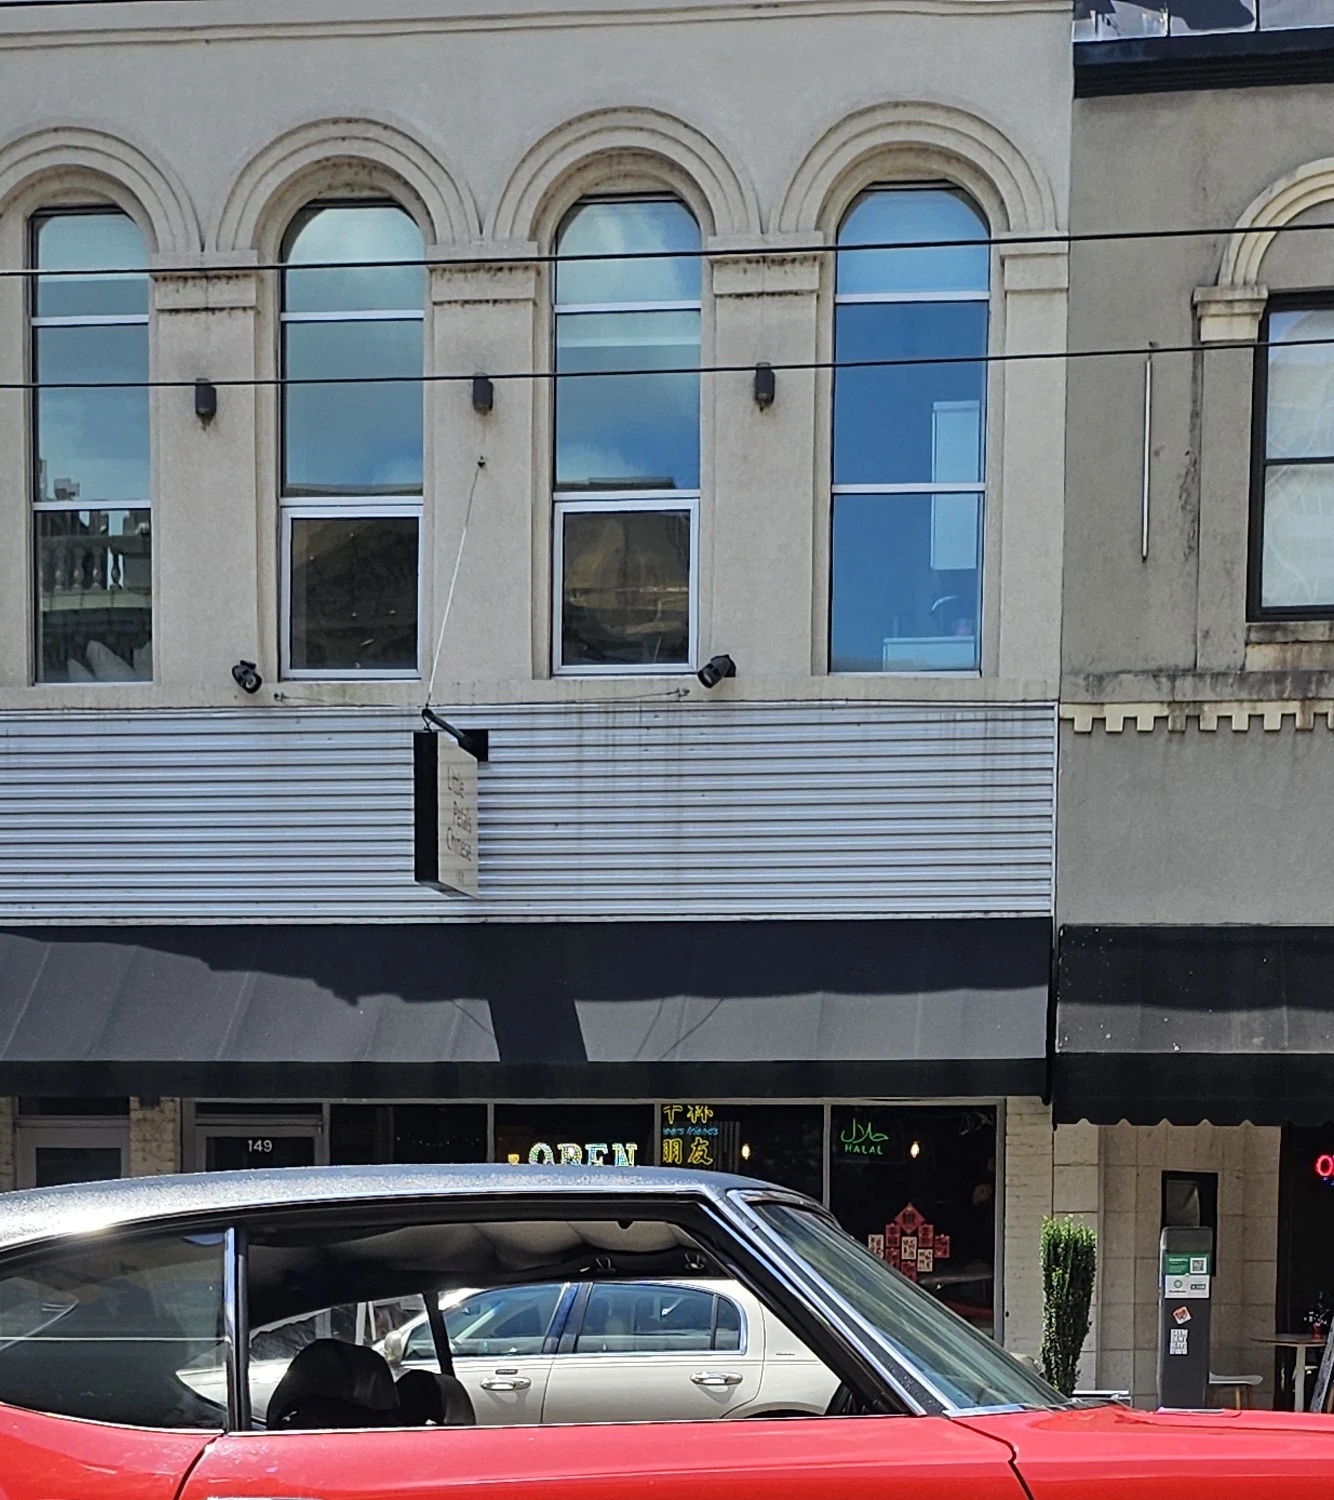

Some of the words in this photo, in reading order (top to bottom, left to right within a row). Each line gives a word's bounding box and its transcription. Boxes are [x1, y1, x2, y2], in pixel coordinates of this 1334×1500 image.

[841, 1118, 889, 1143] حلال
[248, 1139, 273, 1152] 149
[528, 1142, 638, 1167] OPEN
[663, 1137, 714, 1165] 朋友
[844, 1144, 883, 1155] HALAL
